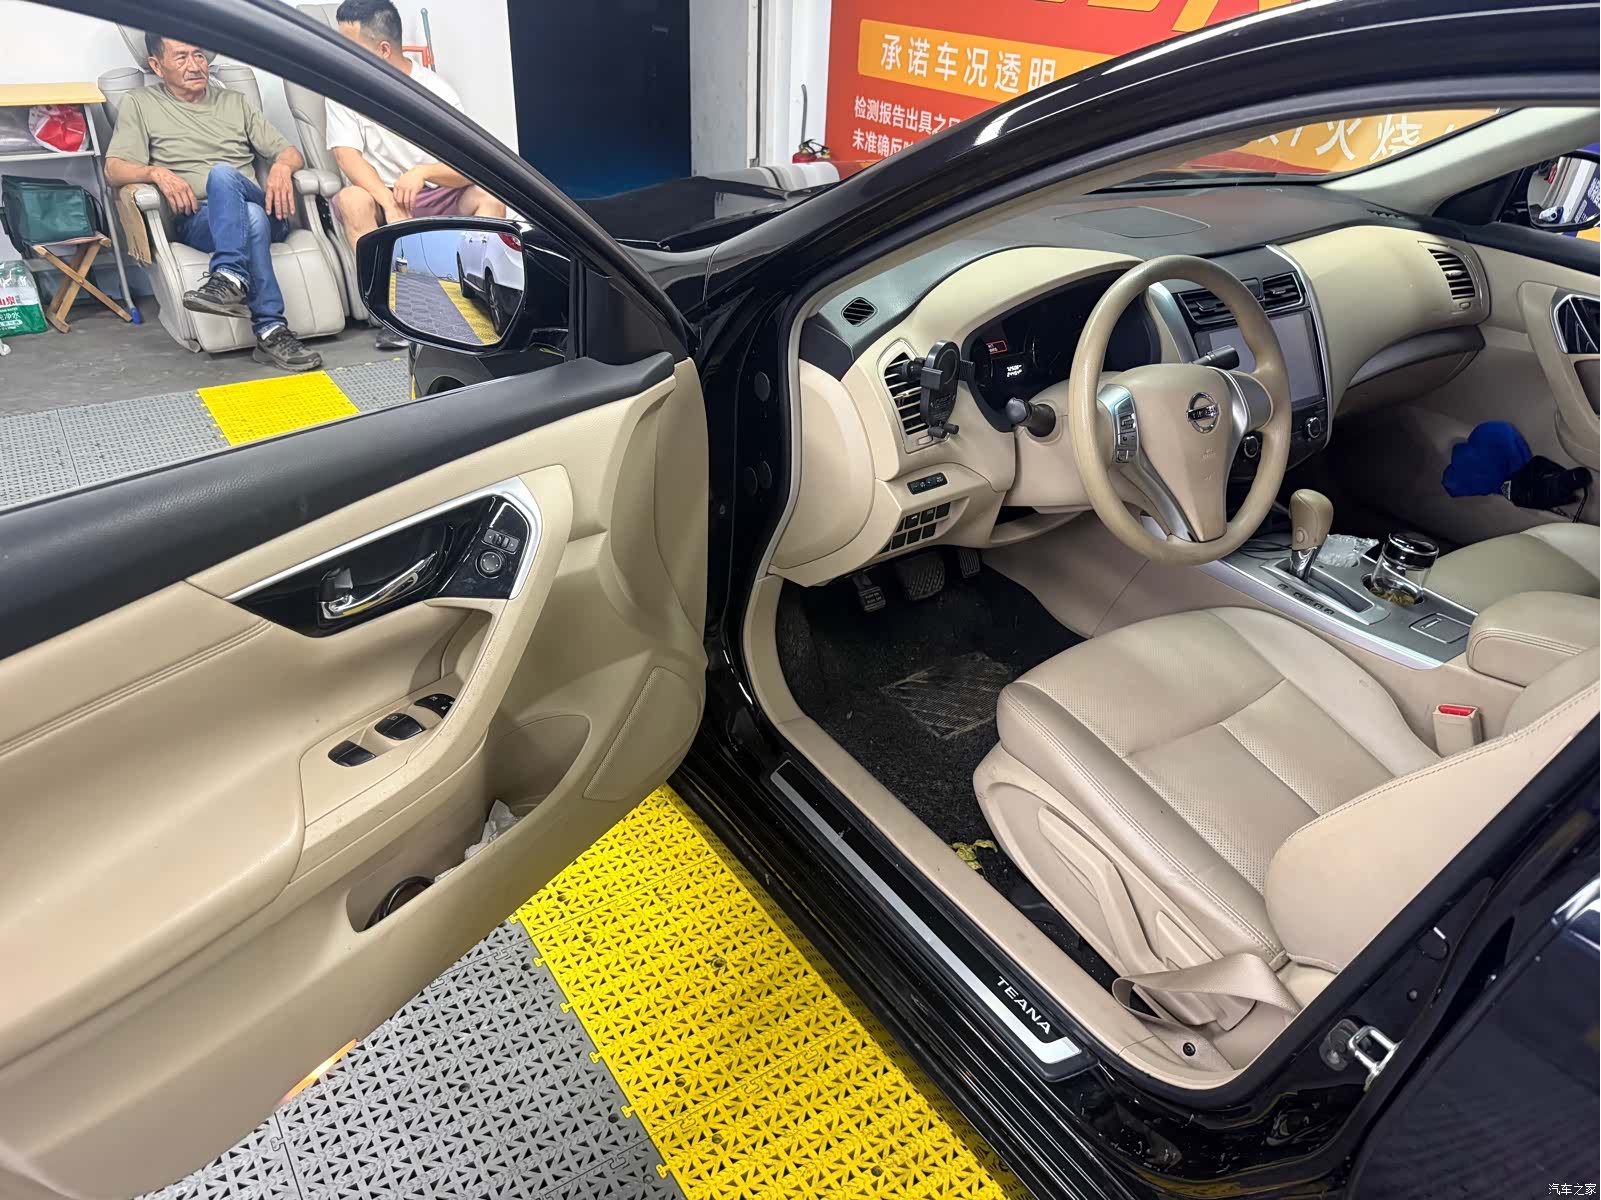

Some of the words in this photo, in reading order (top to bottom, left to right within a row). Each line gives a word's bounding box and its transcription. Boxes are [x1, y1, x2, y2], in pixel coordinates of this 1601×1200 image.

[880, 33, 1057, 94] 承诺车况透明
[997, 975, 1051, 1035] TEANA
